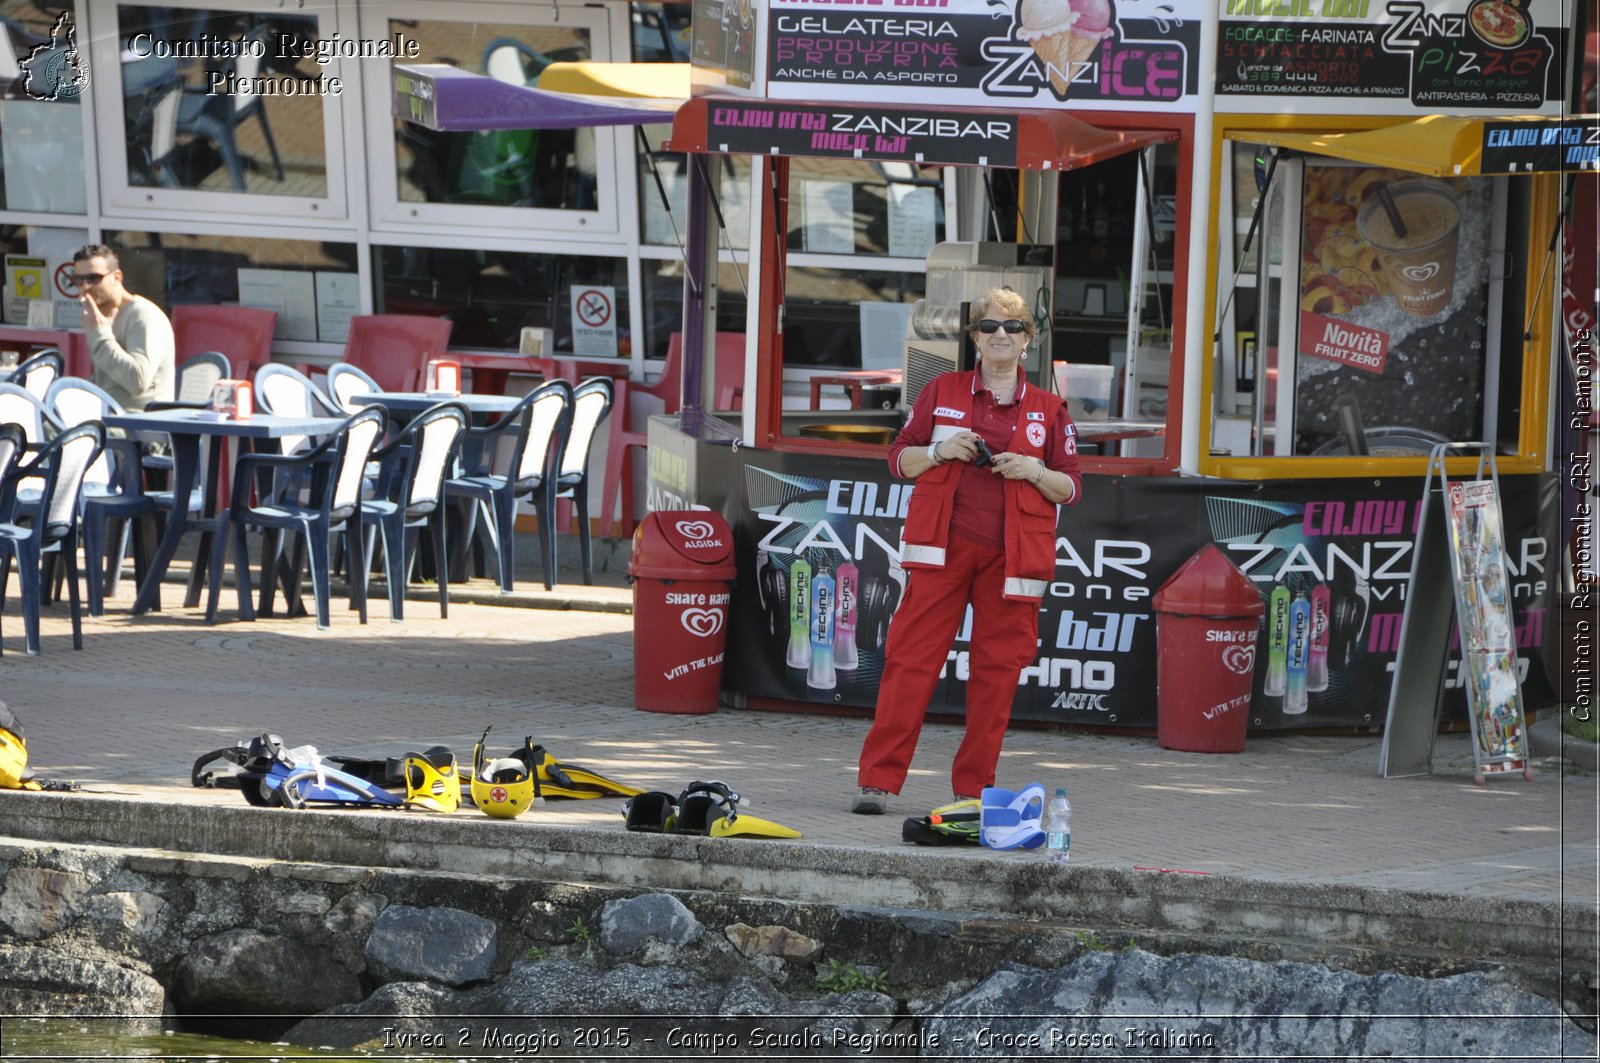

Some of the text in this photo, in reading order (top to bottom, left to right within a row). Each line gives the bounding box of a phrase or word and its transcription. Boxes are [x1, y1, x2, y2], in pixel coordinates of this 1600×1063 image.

[777, 16, 958, 38] GELATERIA
[1387, 4, 1466, 47] ZANZI
[777, 37, 958, 56] PRODUZIONE
[1224, 43, 1375, 59] SCHIACCIATA
[777, 50, 958, 69] PROPRIA
[987, 45, 1099, 93] ZANZI
[1247, 64, 1271, 72] anche
[1284, 61, 1360, 74] ASPORTO
[776, 67, 958, 84] ANCHE DA ASPORTO
[1250, 72, 1281, 82] 389
[1285, 72, 1318, 82] 444
[1222, 84, 1405, 95] SABATO E DOMENICA PIZZA ANCHE A PRANZO
[1416, 91, 1488, 101] ANTIPASTERIA
[1496, 93, 1541, 102] PIZZERIA
[831, 113, 1012, 140] ZANZIBAR
[1322, 322, 1383, 356] Novità
[1315, 342, 1349, 361] FRUIT
[685, 540, 723, 549] ALGIDA
[796, 571, 805, 621] TECHNO
[842, 577, 851, 626] TECHNO
[818, 588, 827, 642] TECHNO
[1276, 597, 1285, 649] TECHNO
[1294, 611, 1304, 667] TECHNO
[663, 663, 690, 681] WITH
[689, 657, 707, 671] THE
[1051, 690, 1111, 712] ARTIC
[1203, 702, 1229, 720] WITH
